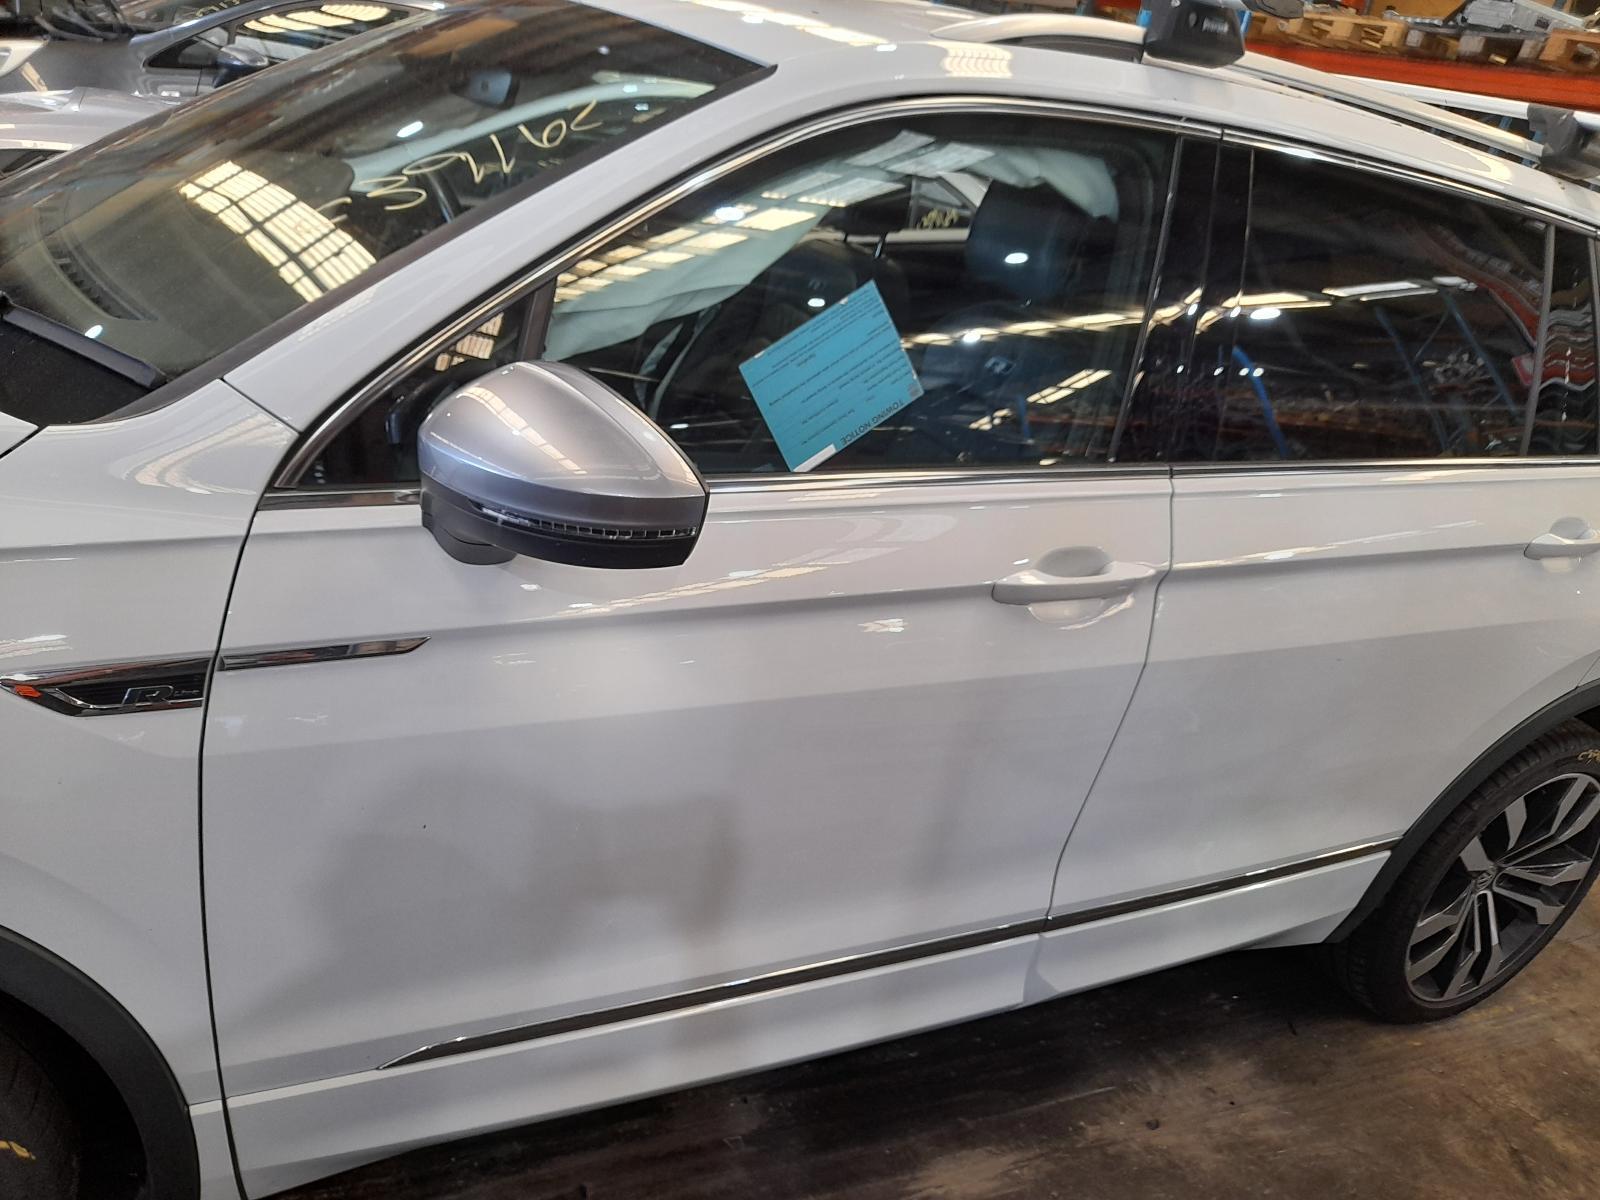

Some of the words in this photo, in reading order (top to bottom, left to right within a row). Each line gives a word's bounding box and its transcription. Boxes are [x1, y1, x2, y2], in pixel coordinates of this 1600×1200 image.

[316, 98, 603, 224] 39162
[871, 399, 904, 424] TOWING
[839, 420, 872, 446] NOTICE
